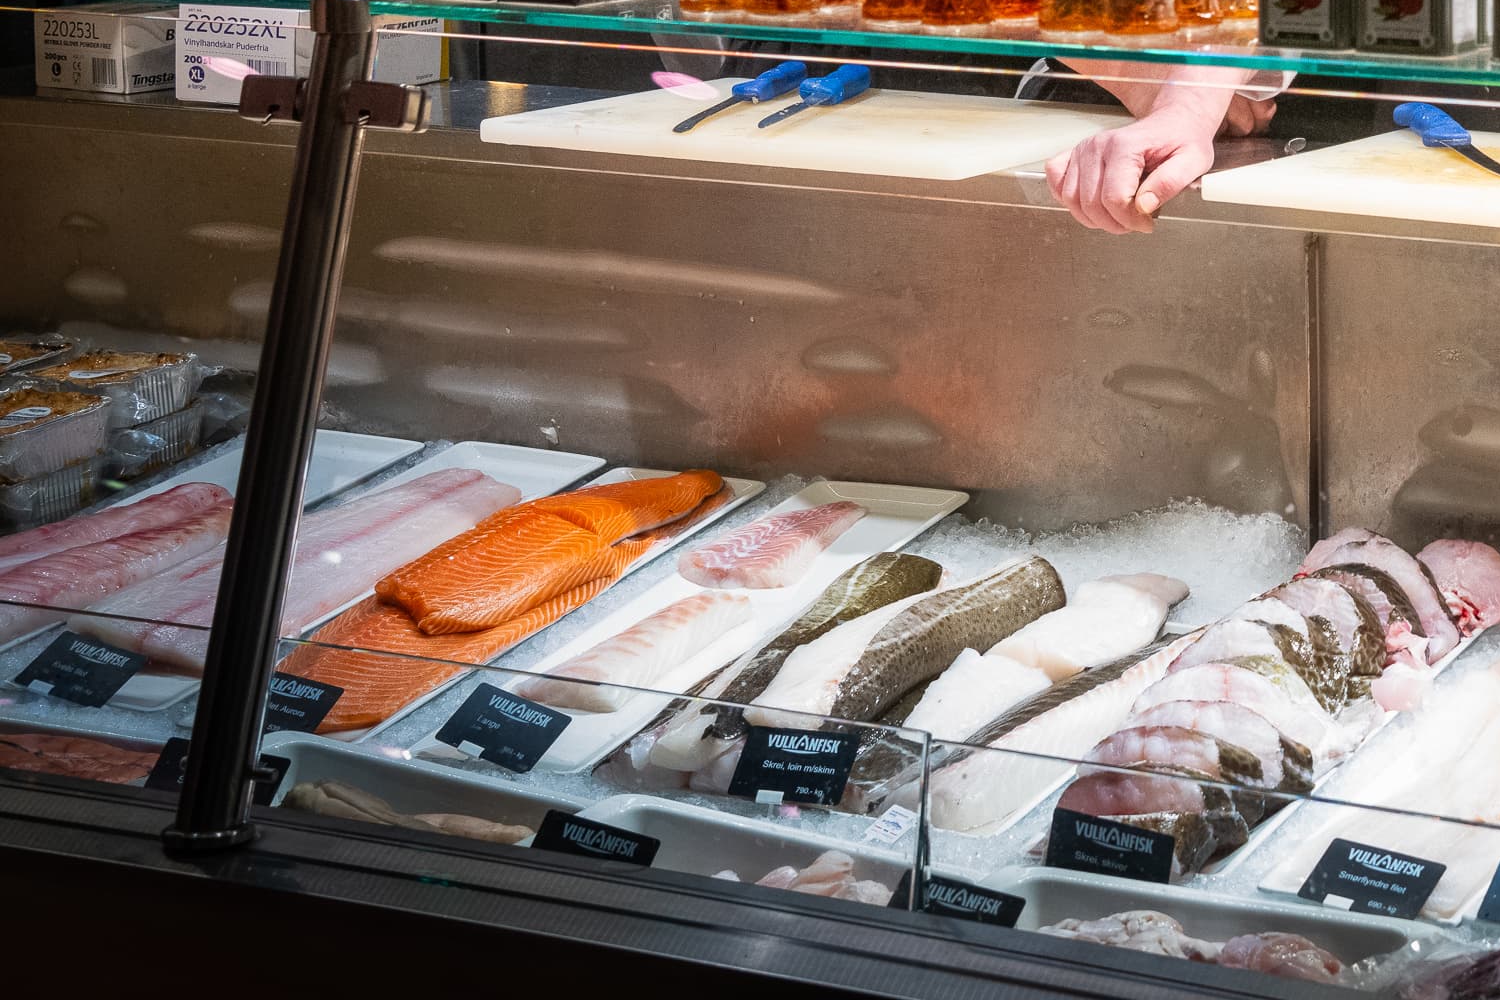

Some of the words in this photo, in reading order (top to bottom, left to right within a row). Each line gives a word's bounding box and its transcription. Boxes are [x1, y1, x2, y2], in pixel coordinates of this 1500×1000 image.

[43, 19, 99, 39] 220253L
[184, 13, 287, 39] 220252XL
[184, 38, 234, 49] Vinylhandskar
[236, 40, 269, 52] Puderfria
[190, 68, 204, 80] XL
[70, 640, 131, 667] VULKANFISK
[488, 694, 553, 728] VULKANFISK
[767, 734, 841, 755] VULKANFISK
[762, 759, 785, 770] Skrei,
[787, 762, 802, 771] loin
[803, 763, 836, 775] m/skinn
[562, 822, 639, 857] VULKANFISK
[1075, 820, 1155, 855] VULKANFISK
[1348, 847, 1425, 878] VULKANFISK
